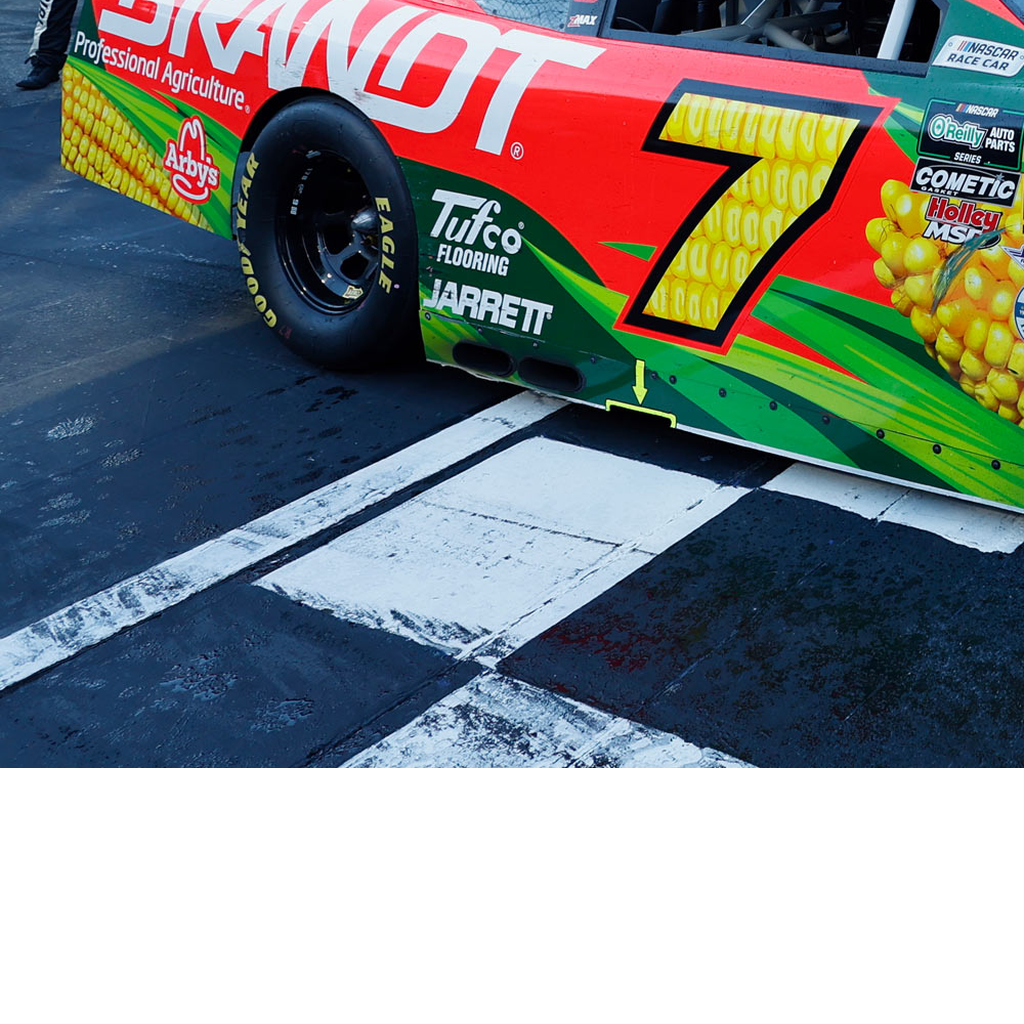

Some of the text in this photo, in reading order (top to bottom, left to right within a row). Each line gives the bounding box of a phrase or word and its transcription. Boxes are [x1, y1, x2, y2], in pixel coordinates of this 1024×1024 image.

[947, 54, 1010, 71] RACE CAR
[968, 42, 1020, 61] NASCAR
[74, 31, 244, 110] Professional Agriculture
[965, 104, 1000, 118] NASCAR
[929, 114, 988, 150] O'Reilly
[985, 137, 1016, 153] PARTS
[989, 126, 1015, 141] AUTO
[954, 152, 981, 164] SERIES
[915, 167, 1015, 199] COMETIC
[431, 189, 522, 254] Tufco
[624, 79, 883, 346] 7
[927, 196, 1000, 232] Holley
[375, 196, 400, 294] EAGLE
[436, 243, 509, 276] FLOORING
[423, 278, 553, 335] JARRETT
